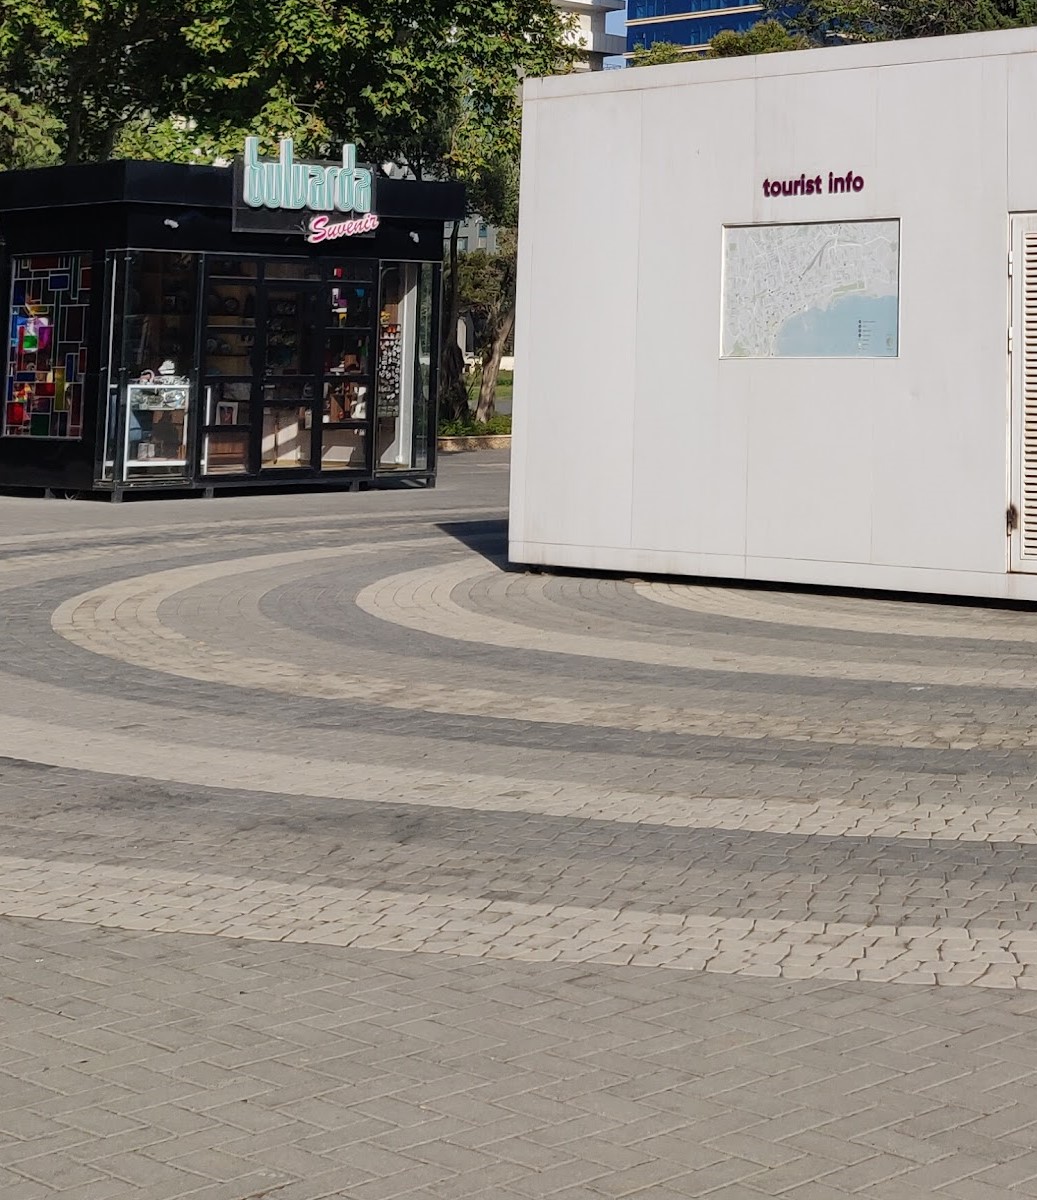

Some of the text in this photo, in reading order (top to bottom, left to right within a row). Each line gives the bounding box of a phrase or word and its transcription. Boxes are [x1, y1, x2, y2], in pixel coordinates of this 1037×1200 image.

[242, 136, 372, 213] bulvarda
[762, 170, 864, 197] tourist info
[307, 212, 380, 244] Suvenir
